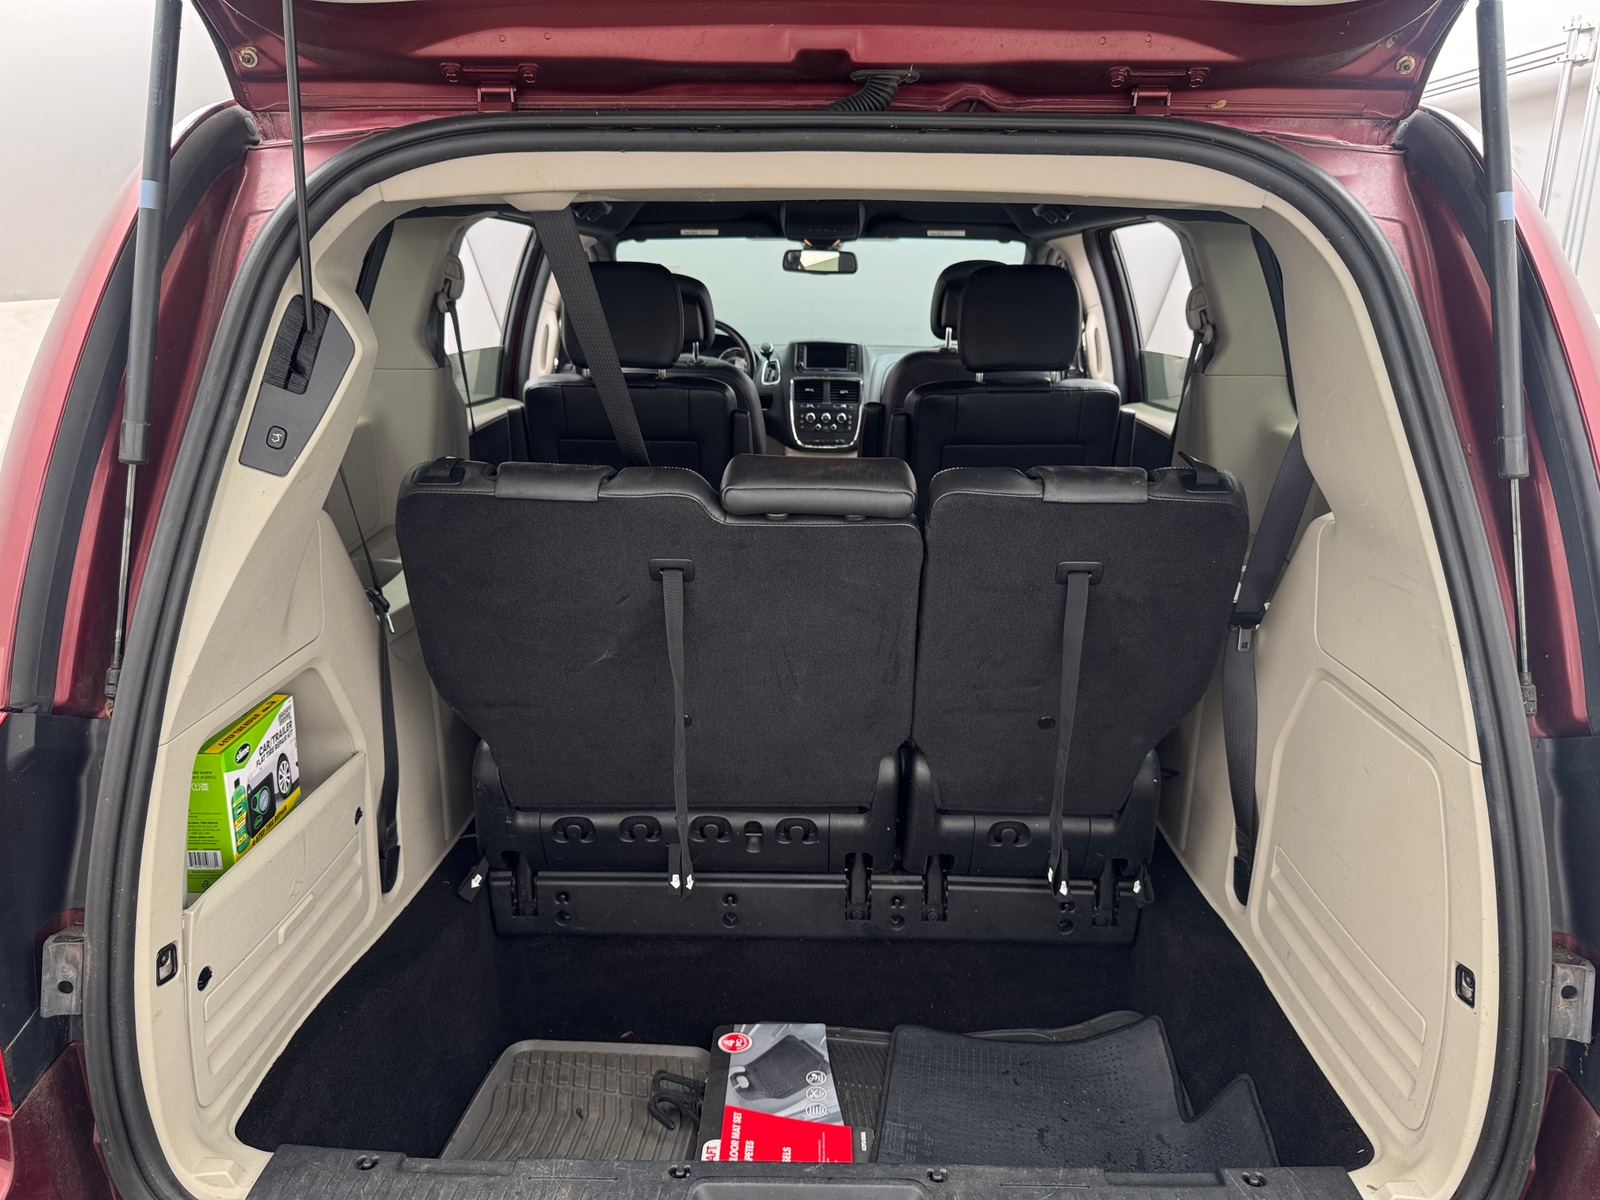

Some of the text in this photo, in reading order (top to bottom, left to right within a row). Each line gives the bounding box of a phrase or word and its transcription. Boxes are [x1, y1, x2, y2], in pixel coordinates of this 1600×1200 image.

[218, 733, 235, 747] 4-STEP
[233, 725, 247, 735] TIRE
[243, 713, 261, 727] REPAIR
[258, 720, 293, 756] CAR/TRAILER
[236, 745, 250, 762] slime
[256, 754, 266, 768] FLAT
[265, 745, 275, 759] TIRE
[274, 733, 288, 752] REPAIR
[265, 818, 275, 830] TIRE
[274, 804, 288, 822] REPAIR
[723, 1039, 736, 1047] 4
[729, 1111, 743, 1161] LOOR MAT SET
[744, 1139, 755, 1161] PETES
